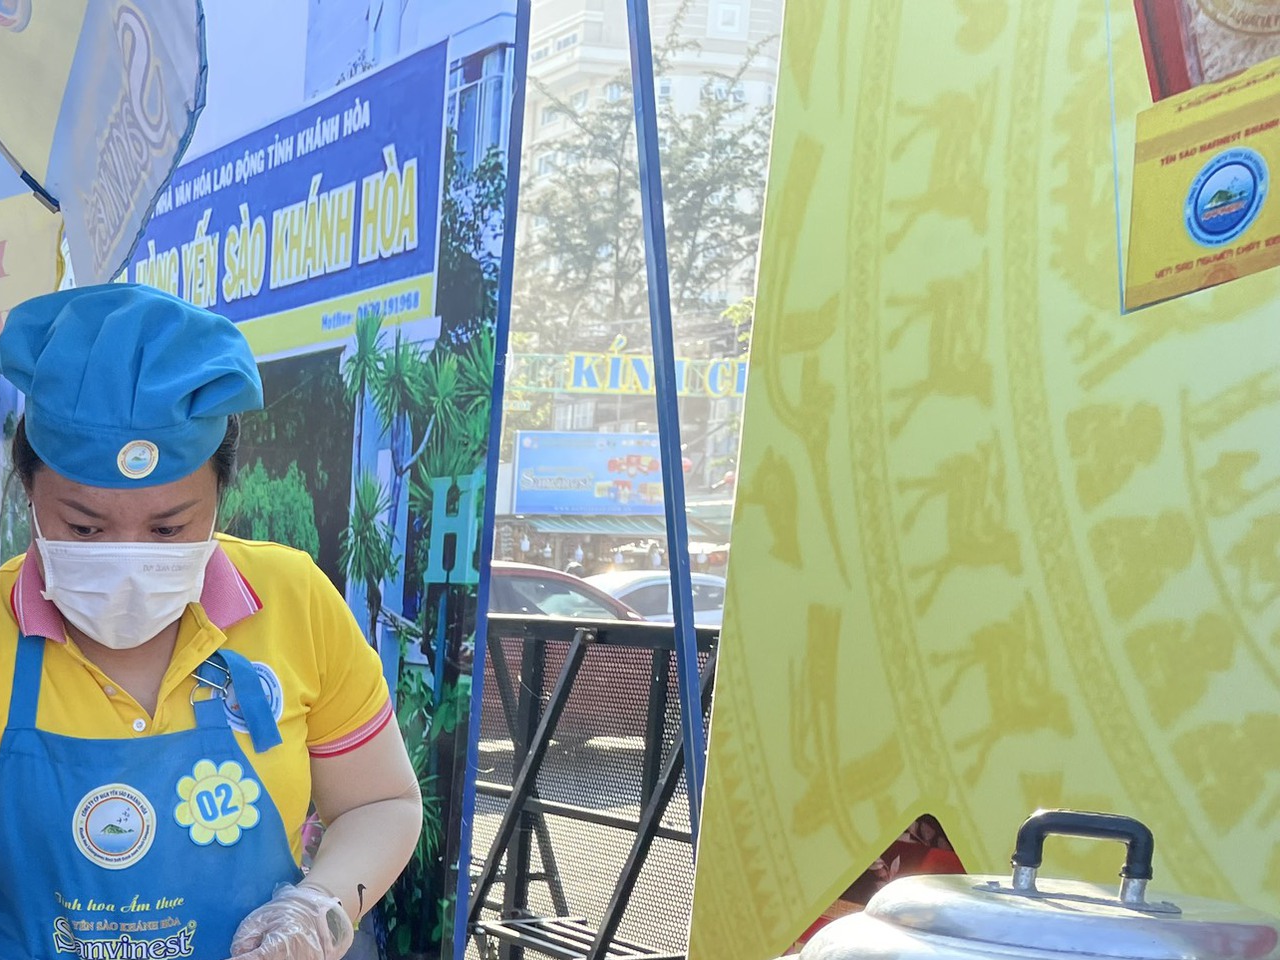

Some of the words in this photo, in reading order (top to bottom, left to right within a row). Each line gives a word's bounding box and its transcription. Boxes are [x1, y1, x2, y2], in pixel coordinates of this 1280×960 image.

[175, 179, 192, 208] VĂN
[193, 167, 211, 200] HÓA
[213, 161, 233, 193] LAO
[235, 150, 265, 185] ĐỘNG
[267, 133, 294, 169] TỈNH
[297, 117, 339, 158] KHÁNH
[343, 97, 371, 136] HÒA
[181, 207, 220, 309] YẾN
[222, 202, 267, 303] SÀO
[270, 172, 356, 290] KHÁNH
[358, 143, 419, 265] HÒA
[196, 783, 239, 822] 02
[72, 919, 95, 931] YẾN
[96, 919, 119, 931] SÀO
[119, 920, 159, 932] KHÁNH
[160, 916, 182, 930] HÒA
[86, 899, 116, 912] hoa
